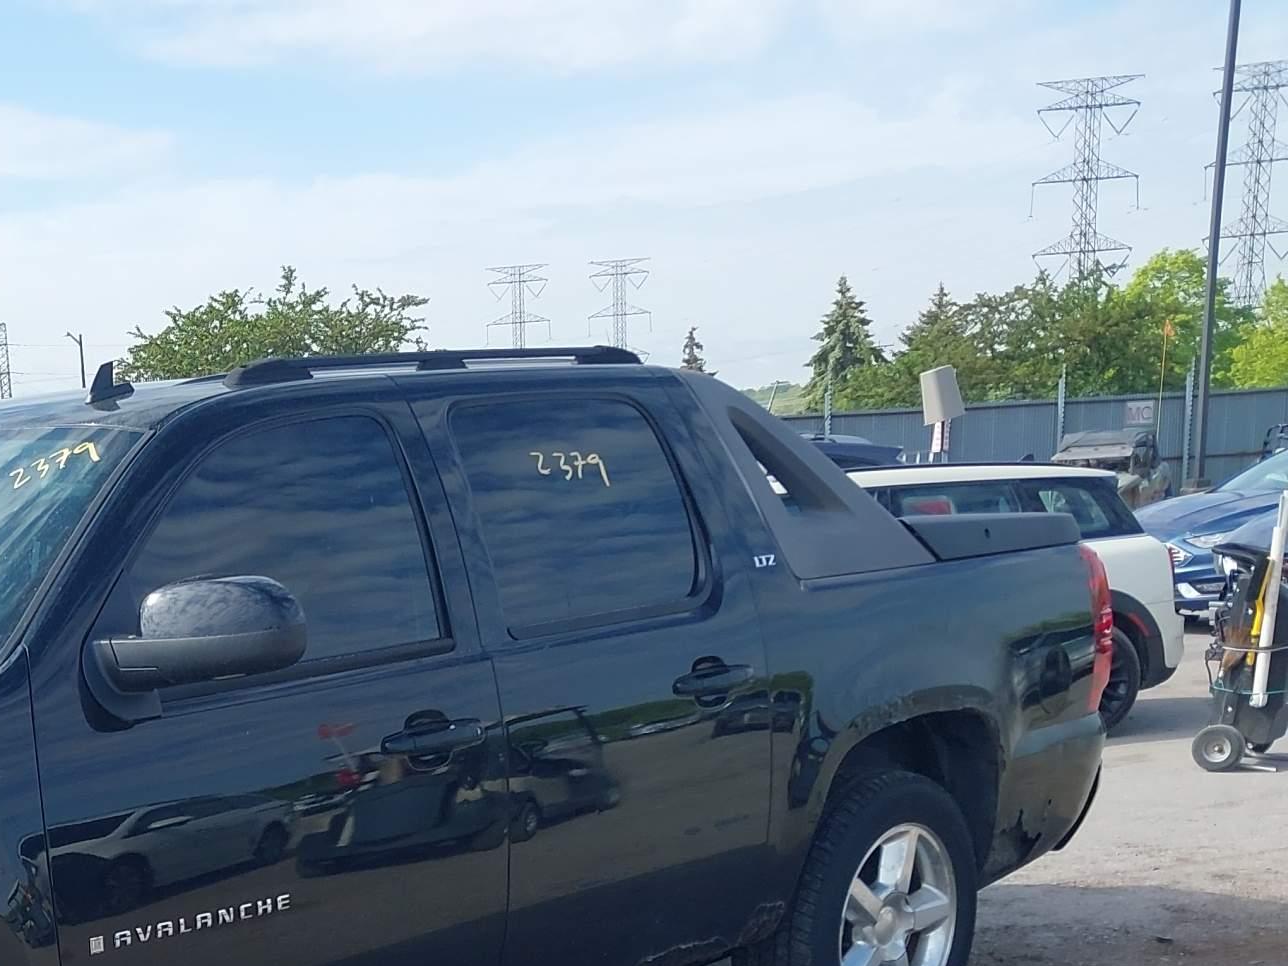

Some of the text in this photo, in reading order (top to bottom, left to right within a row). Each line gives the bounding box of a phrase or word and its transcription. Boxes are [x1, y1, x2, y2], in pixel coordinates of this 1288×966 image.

[9, 441, 101, 490] 2379
[529, 451, 611, 487] 2379
[753, 554, 777, 569] LTZ
[113, 893, 292, 949] AVALANCHE
